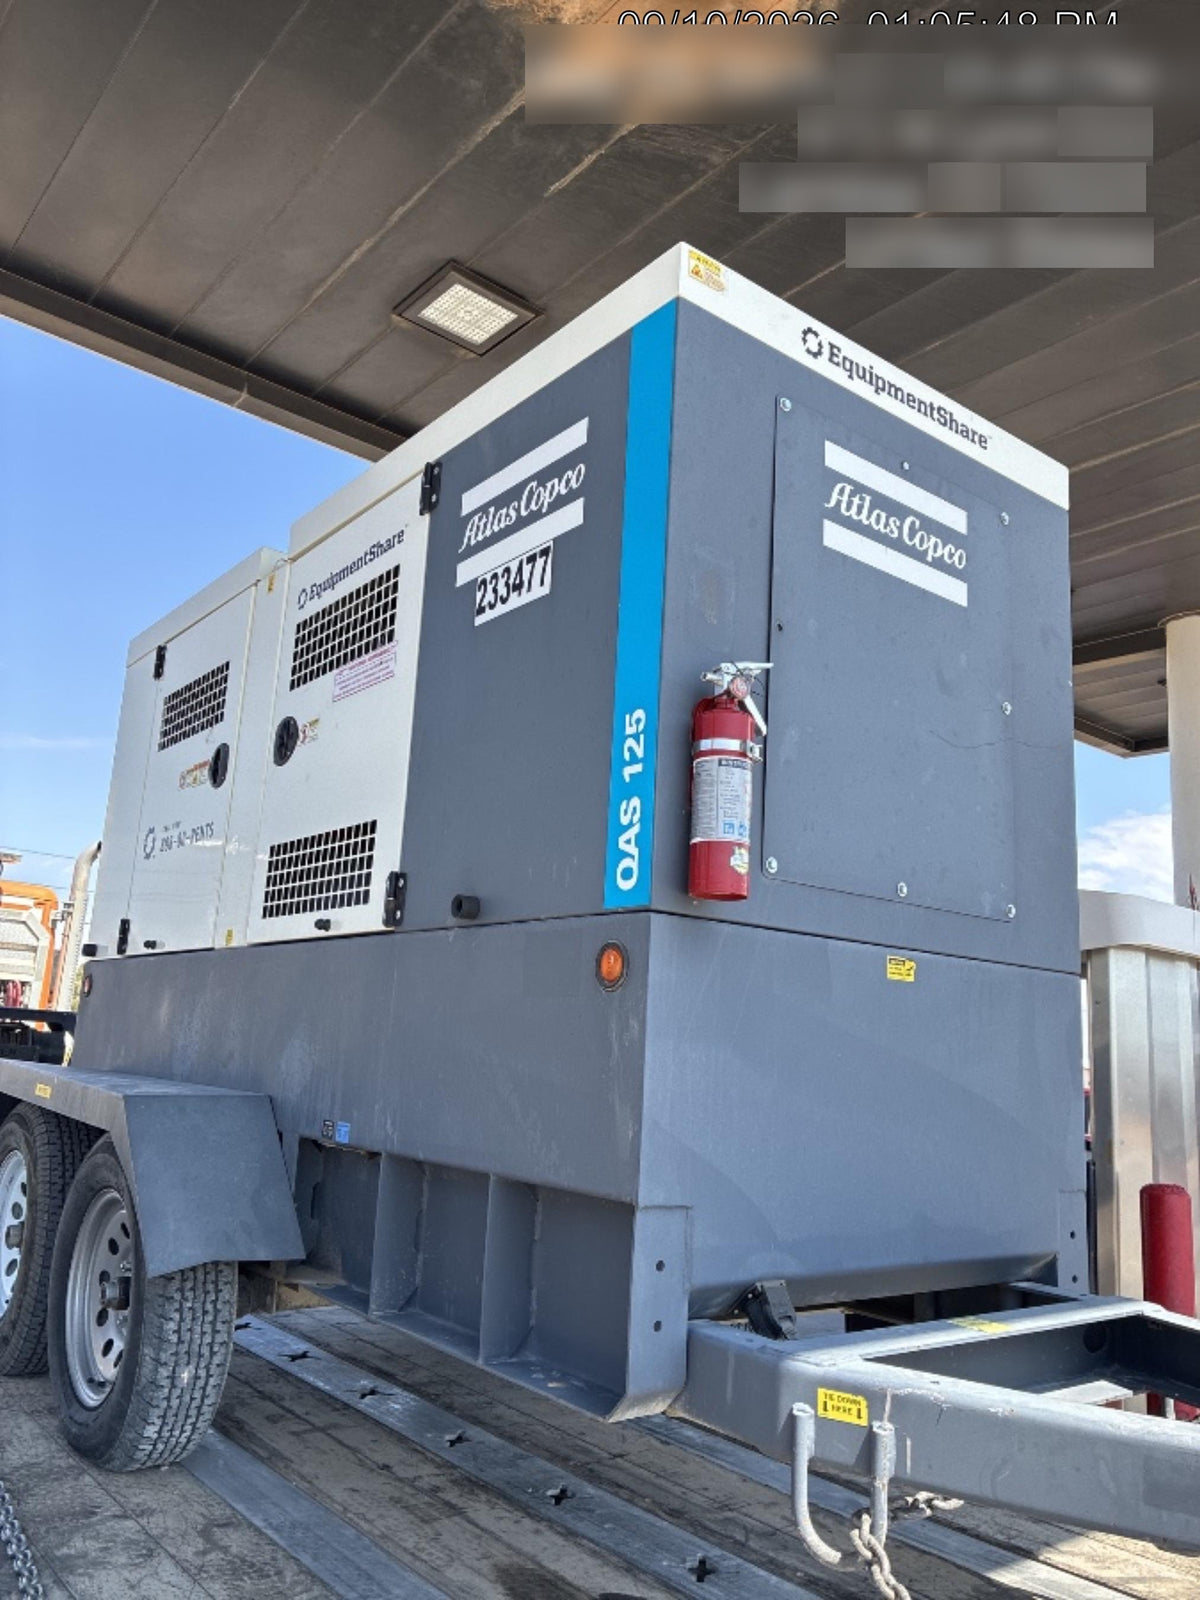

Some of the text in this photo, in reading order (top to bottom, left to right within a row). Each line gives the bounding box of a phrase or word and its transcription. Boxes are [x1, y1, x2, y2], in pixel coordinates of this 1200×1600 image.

[827, 341, 989, 451] EquipmentShare
[458, 463, 587, 554] Atlas Copco
[824, 482, 968, 570] Atlas Copco
[308, 529, 405, 604] EquipmentShare
[475, 545, 552, 617] 233477
[622, 708, 646, 783] 125
